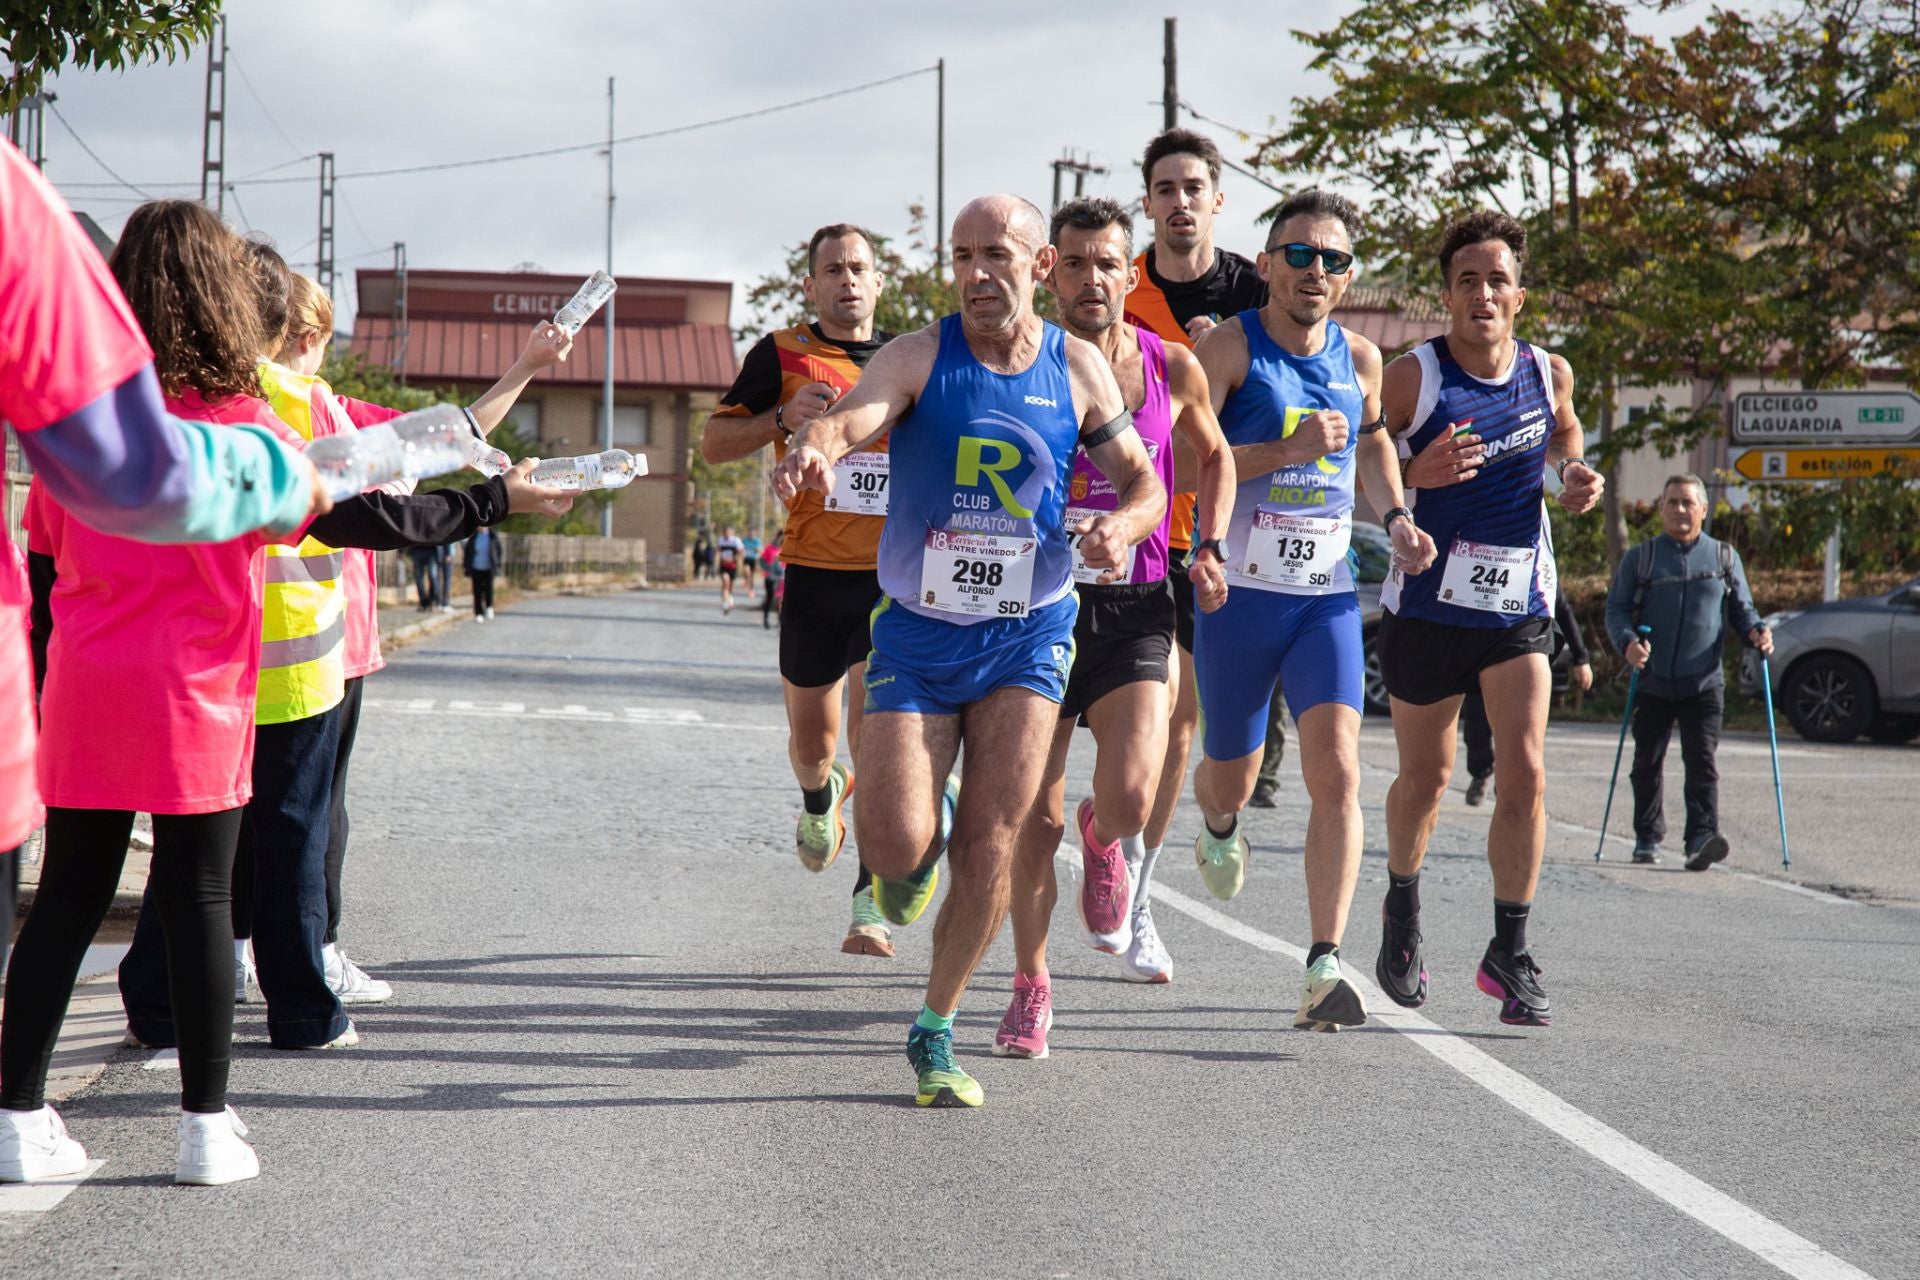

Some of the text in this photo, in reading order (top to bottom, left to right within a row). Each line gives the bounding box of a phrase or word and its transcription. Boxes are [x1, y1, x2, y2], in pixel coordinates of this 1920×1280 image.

[493, 294, 572, 313] CENICE
[1742, 398, 1818, 412] ELCIEGO
[1741, 418, 1842, 432] LAGUARDIA
[1482, 418, 1547, 458] NNERS
[850, 471, 889, 492] 307
[955, 436, 1033, 518] R
[1271, 472, 1329, 487] MARATÓN
[953, 492, 990, 510] CLUB
[1267, 486, 1326, 506] RIOJA
[951, 512, 1017, 533] MARATÓN
[1258, 512, 1274, 530] 18
[1273, 525, 1327, 535] ENTRE VIÑEDOS
[931, 530, 948, 550] 18
[1277, 537, 1316, 561] 133
[948, 544, 1017, 556] ENTRE VIÑEDOS
[1455, 541, 1470, 559] 18
[1469, 552, 1493, 562] ENTRE
[1283, 559, 1304, 568] JESUS
[952, 559, 1004, 587] 298
[1308, 572, 1331, 586] SDi
[1469, 565, 1510, 588] 244
[957, 584, 995, 596] ALFONSO
[1474, 585, 1500, 595] MANUEL
[997, 600, 1025, 614] SDi
[1501, 599, 1525, 612] SDi
